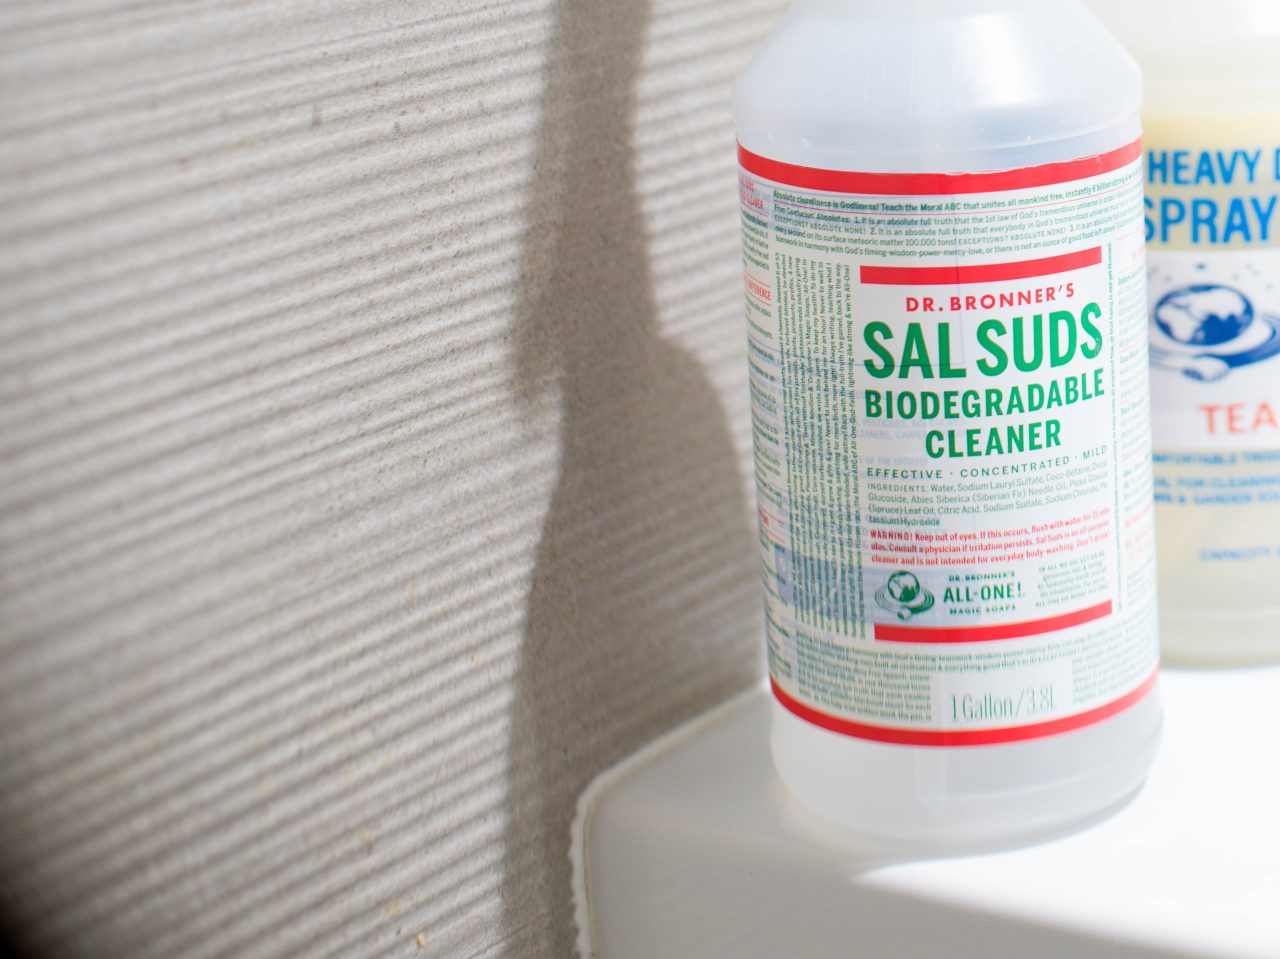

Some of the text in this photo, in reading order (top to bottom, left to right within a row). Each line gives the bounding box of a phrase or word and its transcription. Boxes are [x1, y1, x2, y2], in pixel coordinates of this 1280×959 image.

[1146, 148, 1261, 186] HEAVY
[797, 194, 832, 208] cleanliness
[840, 200, 880, 210] Godliness!
[881, 202, 904, 212] Teach
[906, 203, 918, 211] the
[920, 203, 943, 212] Moral
[944, 202, 961, 210] ABC
[963, 202, 980, 210] that
[982, 200, 1006, 208] unites
[1008, 198, 1017, 207] all
[1018, 194, 1048, 204] mankind
[1065, 186, 1092, 198] instantly
[886, 218, 918, 226] absolute
[920, 218, 932, 226] full
[934, 217, 953, 225] truth
[954, 216, 970, 224] that
[986, 215, 996, 223] 1st
[1020, 211, 1038, 219] God's
[1040, 205, 1076, 216] tremendous
[904, 228, 937, 236] absolute
[938, 228, 951, 236] full
[973, 226, 988, 234] that
[990, 223, 1026, 234] everybody
[1035, 219, 1053, 228] God's
[1054, 214, 1088, 224] tremendous
[804, 242, 830, 253] harmony
[845, 246, 864, 255] God's
[1021, 242, 1032, 250] not
[1042, 239, 1060, 248] ounce
[1068, 234, 1082, 244] good
[822, 234, 847, 243] surface
[848, 236, 878, 245] meteoric
[880, 238, 904, 246] matter
[906, 238, 937, 247] 100,000
[938, 237, 957, 246] tons!
[958, 235, 1008, 246] EXCEPTIONS?
[1010, 229, 1045, 240] ABSOLUTE
[826, 284, 834, 314] teaching
[906, 283, 1074, 312] DR. BRONNER'S
[863, 302, 1103, 380] SAL SUDS
[864, 367, 1105, 420] BIODEGRADABLE
[1196, 399, 1280, 435] TEA
[925, 418, 1062, 460] CLEANER
[867, 444, 1108, 479] EFFECTIVE CONCENTRATED MILD
[867, 482, 929, 492] INGREDIENTS:
[930, 484, 956, 493] Water,
[957, 482, 988, 492] Sodium
[990, 480, 1015, 490] Lauryl
[1016, 476, 1044, 486] Sulfate,
[868, 493, 909, 504] Glucoside,
[911, 495, 934, 504] Abies
[936, 494, 970, 504] Siberica
[972, 492, 1010, 503] (Siberian
[1012, 490, 1026, 500] Fir)
[1028, 485, 1054, 496] Needle
[1056, 482, 1068, 491] Oil,
[1070, 478, 1087, 487] Picea
[868, 504, 902, 514] (Spruce)
[904, 506, 922, 514] Leaf
[923, 506, 936, 516] Oil,
[938, 506, 960, 515] Citric
[961, 505, 982, 514] Acid,
[983, 502, 1014, 513] Sodium
[1016, 498, 1044, 510] Sulfate,
[1045, 492, 1072, 504] Sodium
[868, 516, 941, 527] tassium Hydroxide
[870, 514, 1091, 542] WARNING! Keep out of eyes. If this occurs, flush with water for
[888, 544, 917, 553] Consult
[924, 544, 960, 555] physician
[962, 544, 968, 552] if
[969, 541, 1003, 552] irritation
[1003, 540, 1033, 552] persists.
[1036, 536, 1046, 544] Sal
[1048, 532, 1063, 542] Suds
[871, 550, 1024, 565] cleaner and is not intended for everyday
[948, 570, 1016, 582] DR. BRONNER'S
[943, 581, 1022, 604] ALL-ONE!
[950, 604, 1016, 615] MAGIC SOAPS
